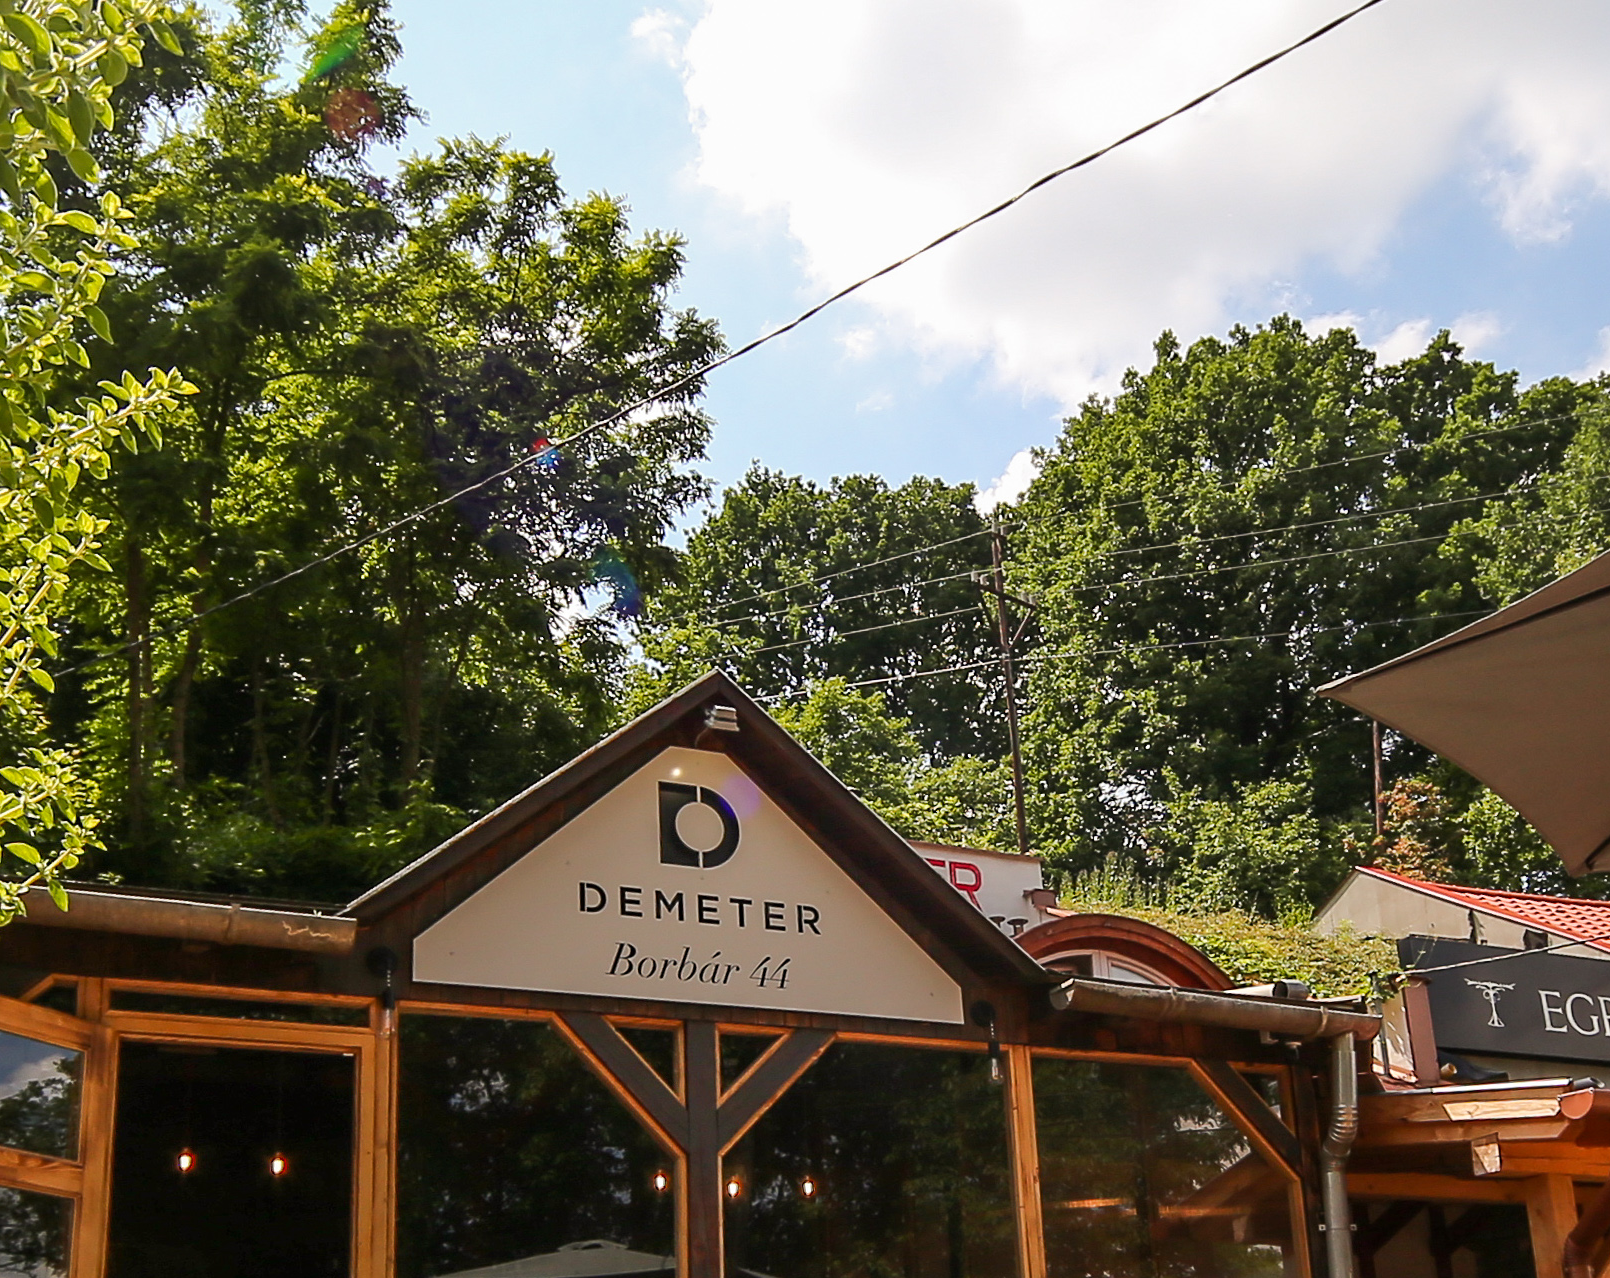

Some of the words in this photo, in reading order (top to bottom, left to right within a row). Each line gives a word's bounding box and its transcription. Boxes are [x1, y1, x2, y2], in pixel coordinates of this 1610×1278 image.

[579, 882, 821, 936] DEMETER
[924, 858, 982, 911] R
[605, 942, 740, 985] Borbár
[749, 956, 791, 989] 44
